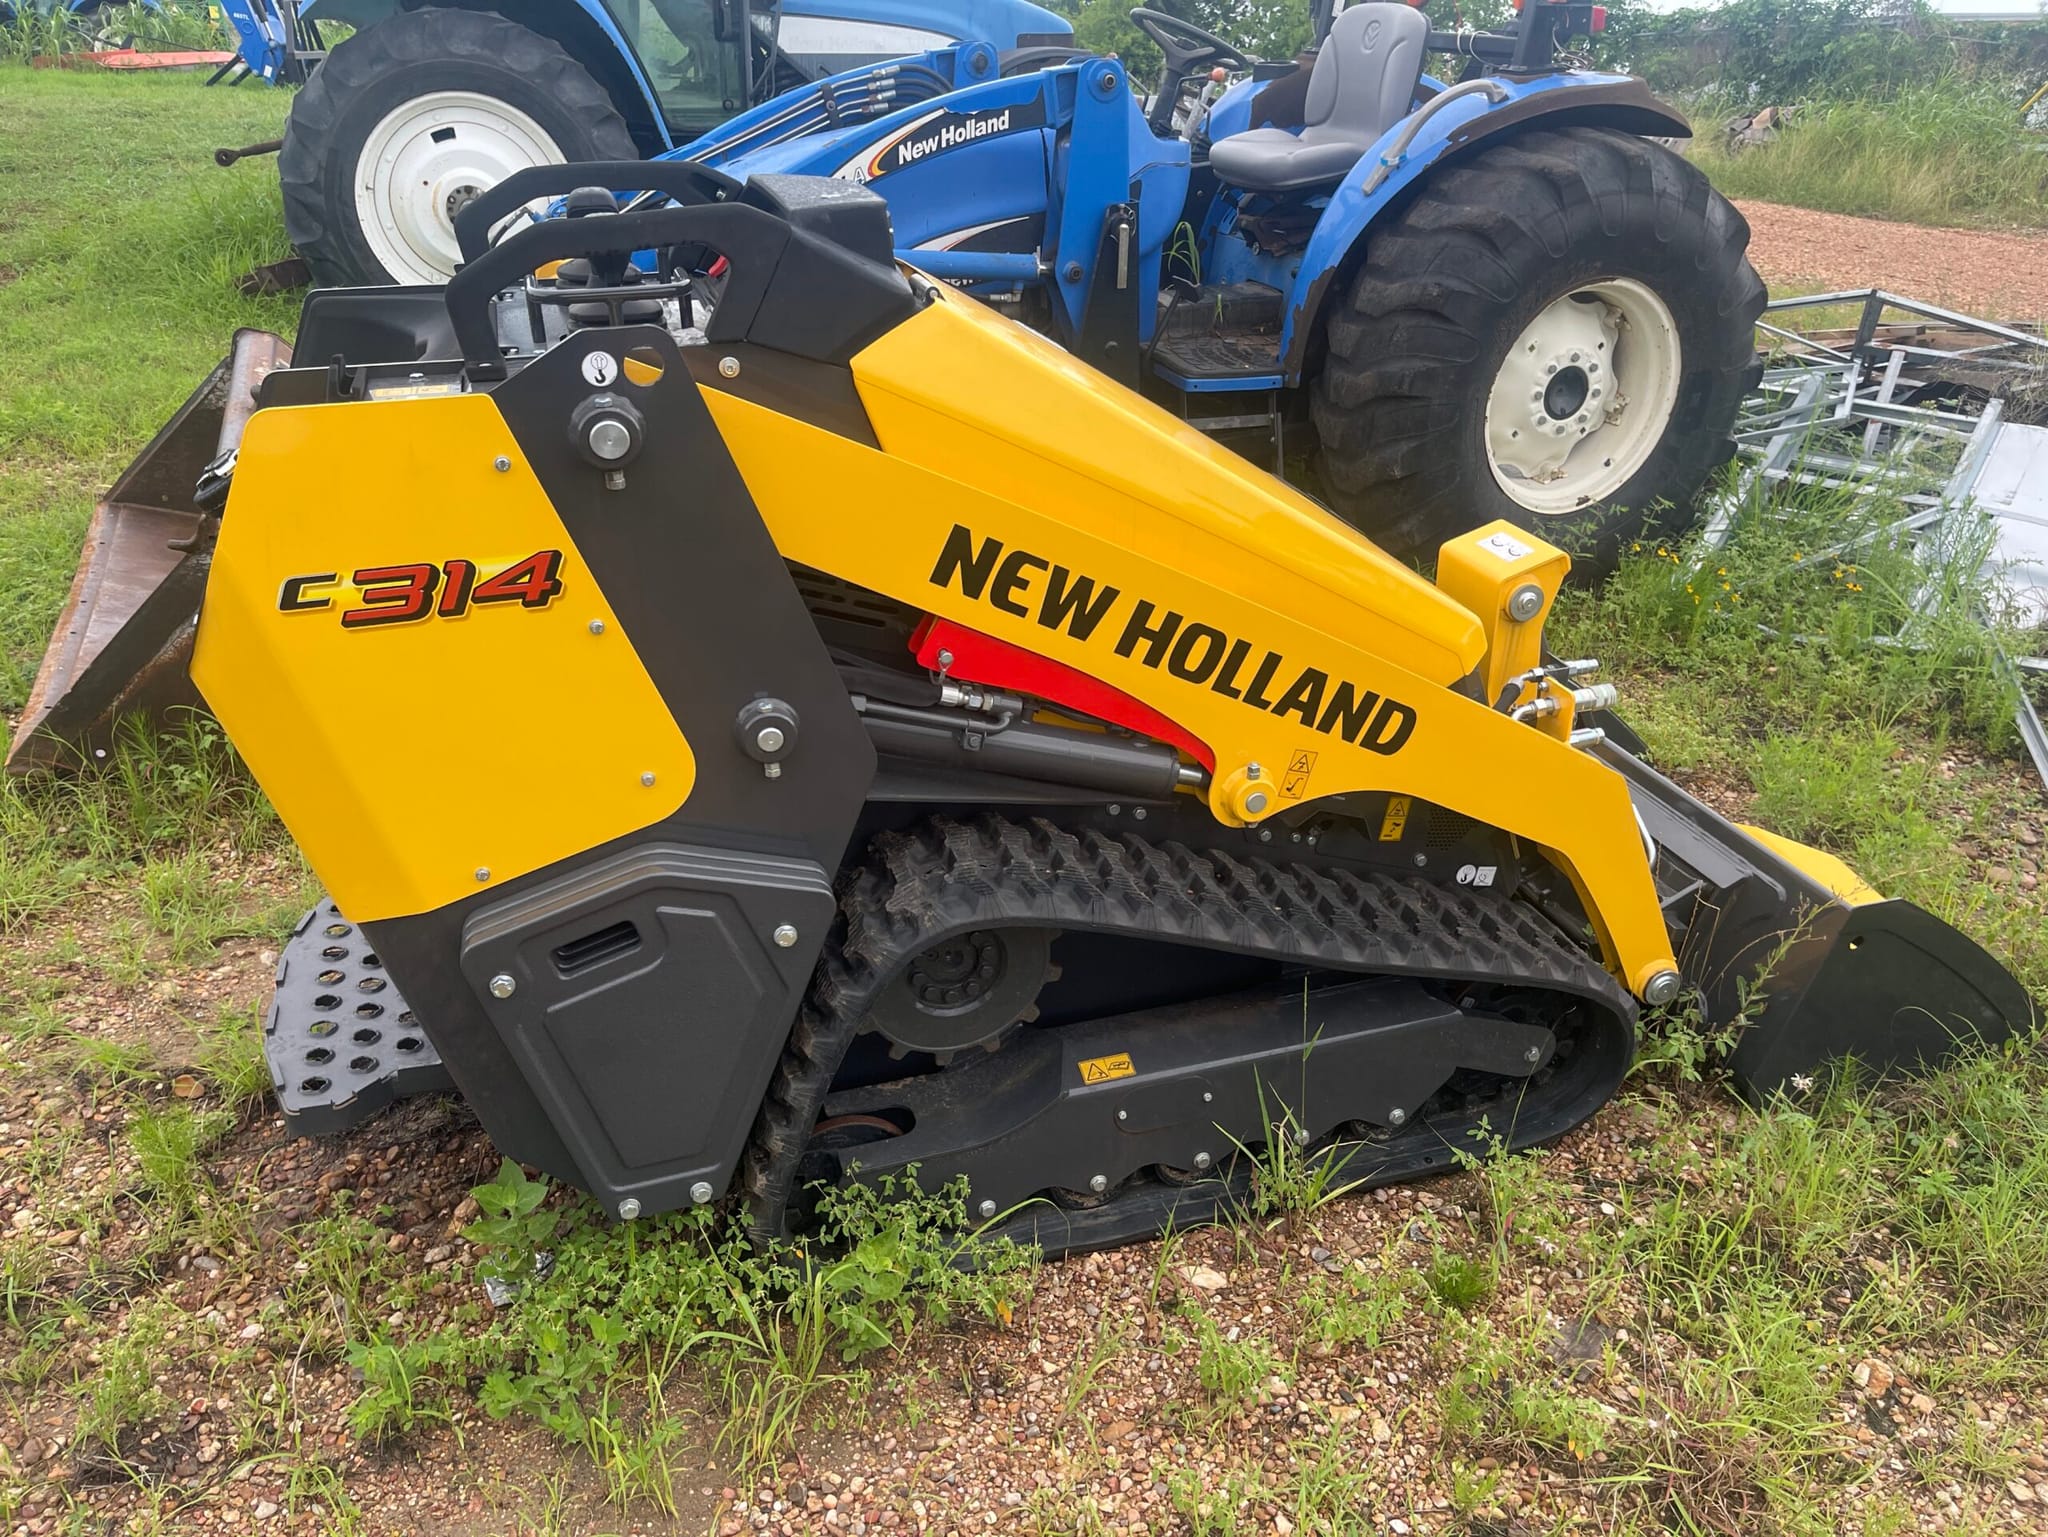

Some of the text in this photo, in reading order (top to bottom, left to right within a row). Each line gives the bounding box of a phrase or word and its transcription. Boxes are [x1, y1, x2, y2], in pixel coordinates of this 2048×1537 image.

[898, 109, 1010, 165] New Holland
[928, 523, 1418, 756] NEW HOLLAND
